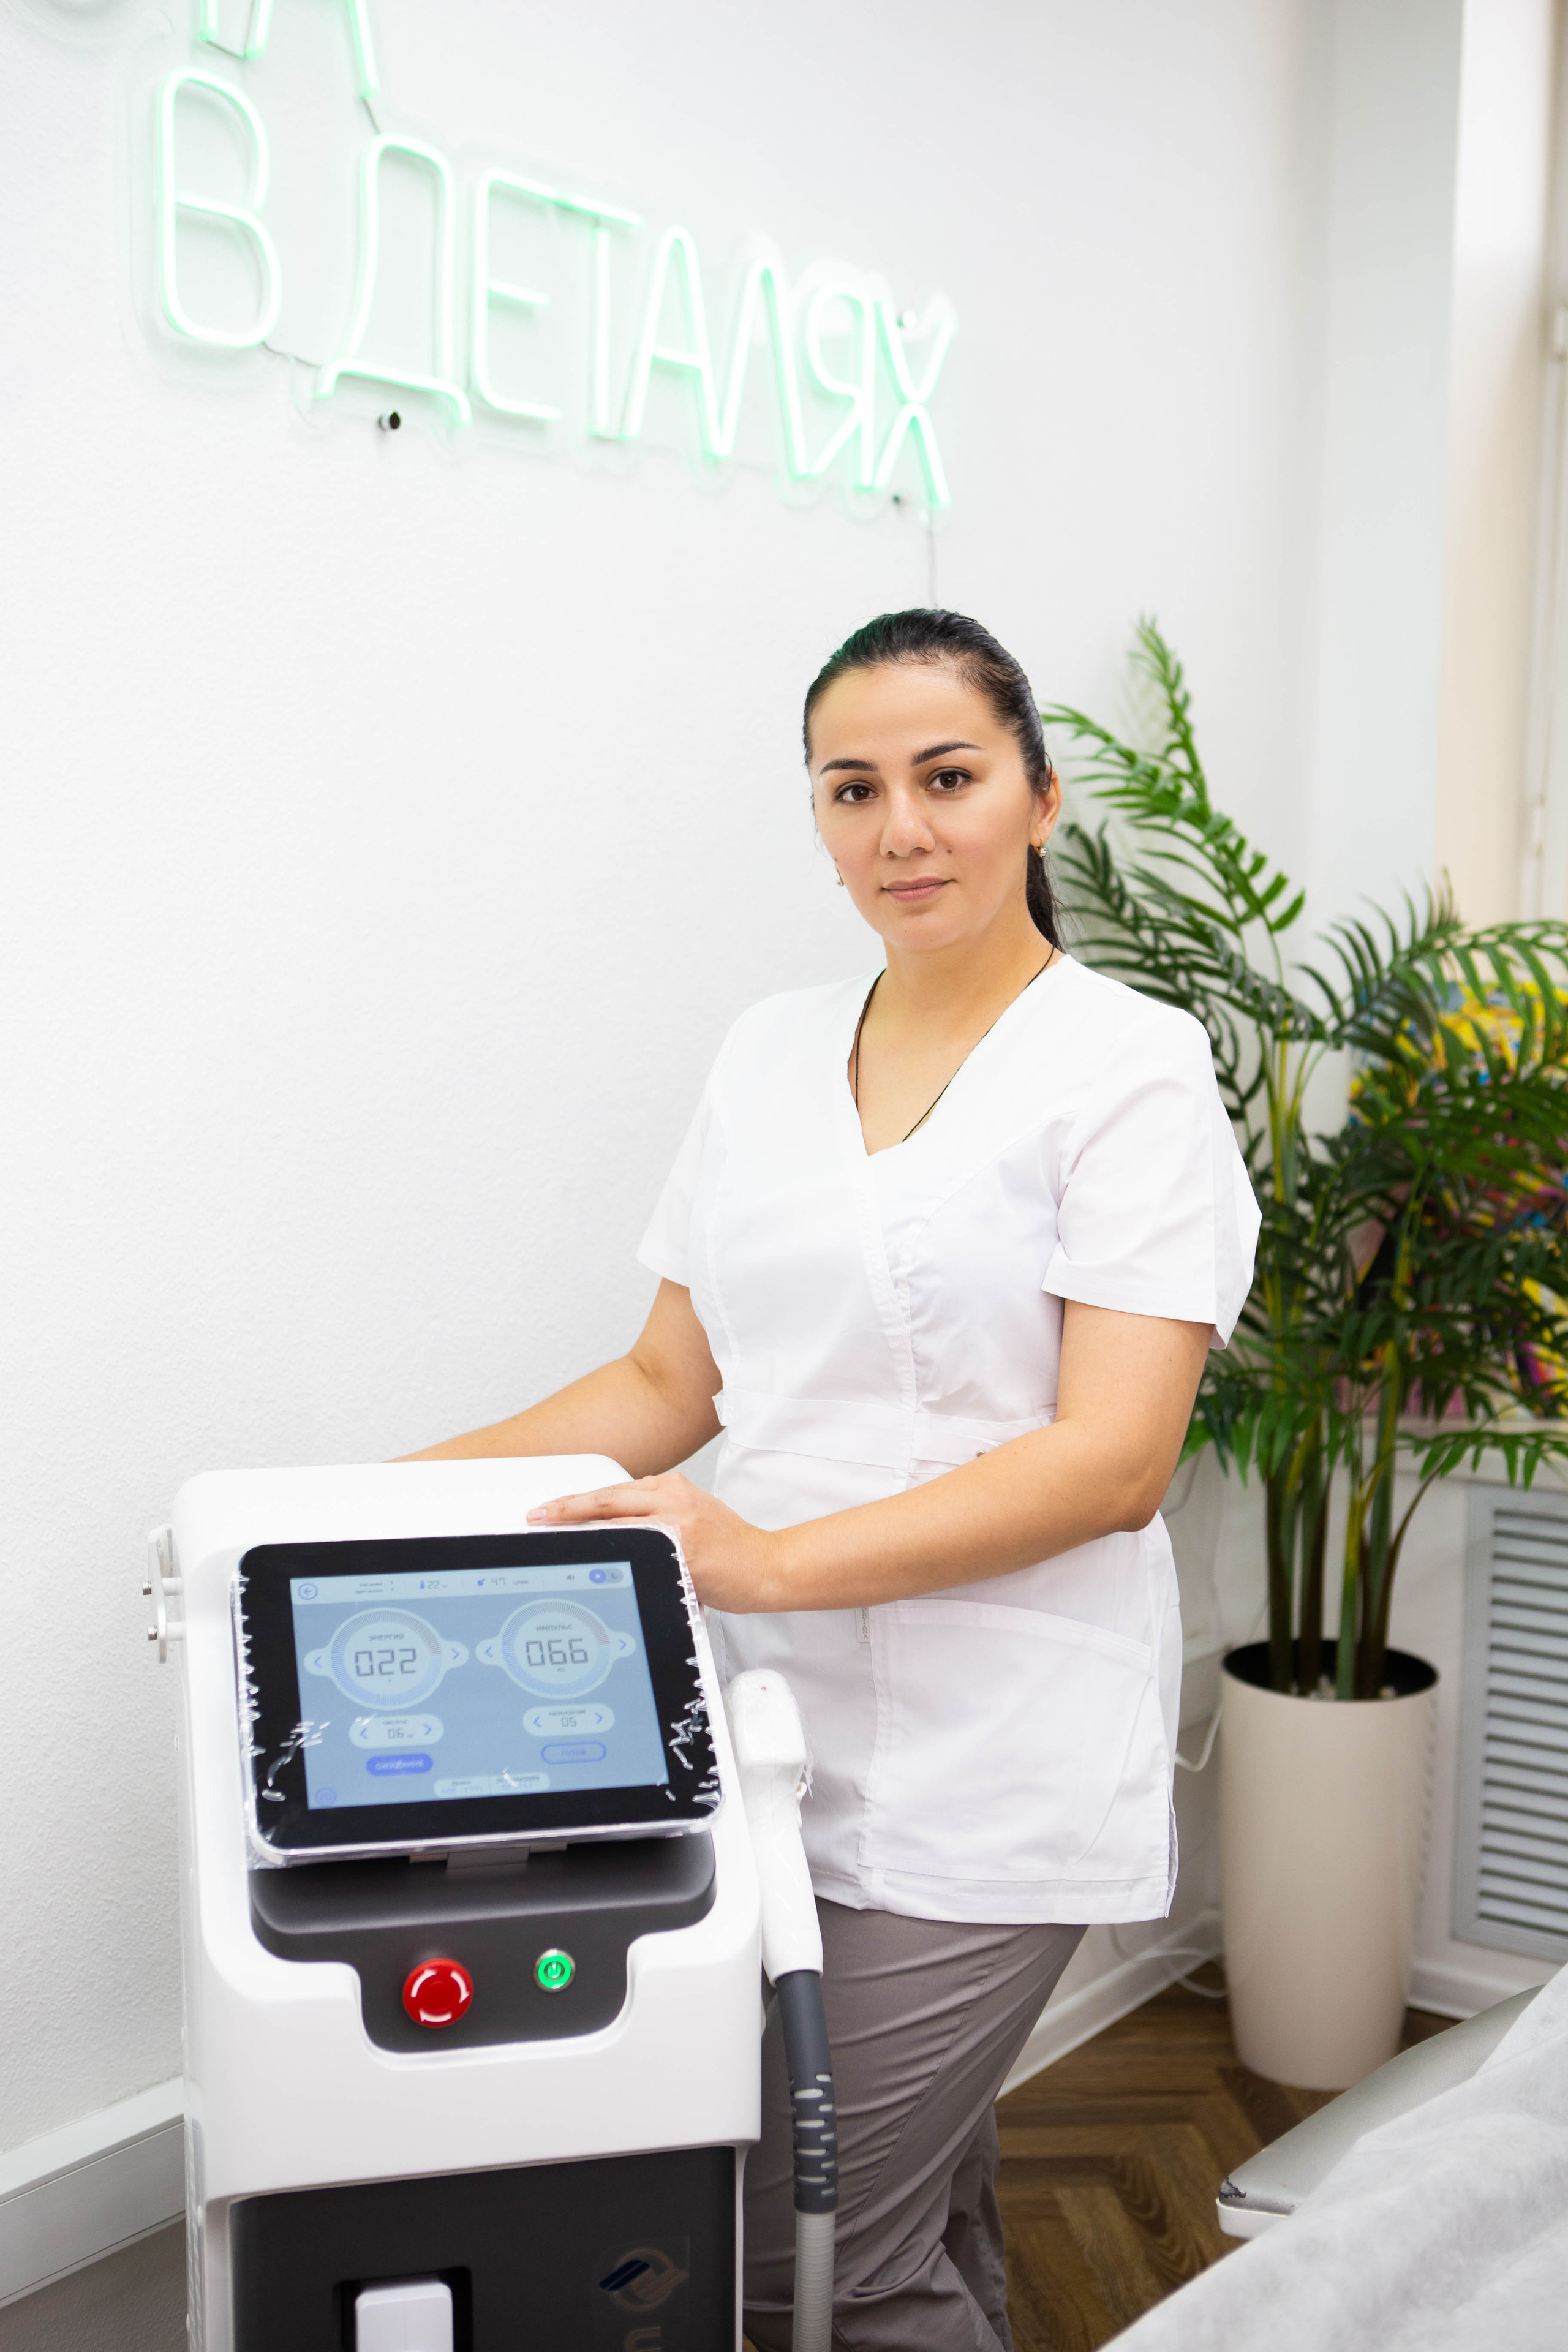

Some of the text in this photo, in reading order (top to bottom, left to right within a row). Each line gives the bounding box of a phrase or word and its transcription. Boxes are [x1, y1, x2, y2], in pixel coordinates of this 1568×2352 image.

[157, 65, 958, 510] В ДЕТАЛЯХ
[355, 1648, 417, 1677] 022
[526, 1638, 589, 1666] 066
[387, 1728, 405, 1740] 06
[561, 1716, 577, 1727] 05
